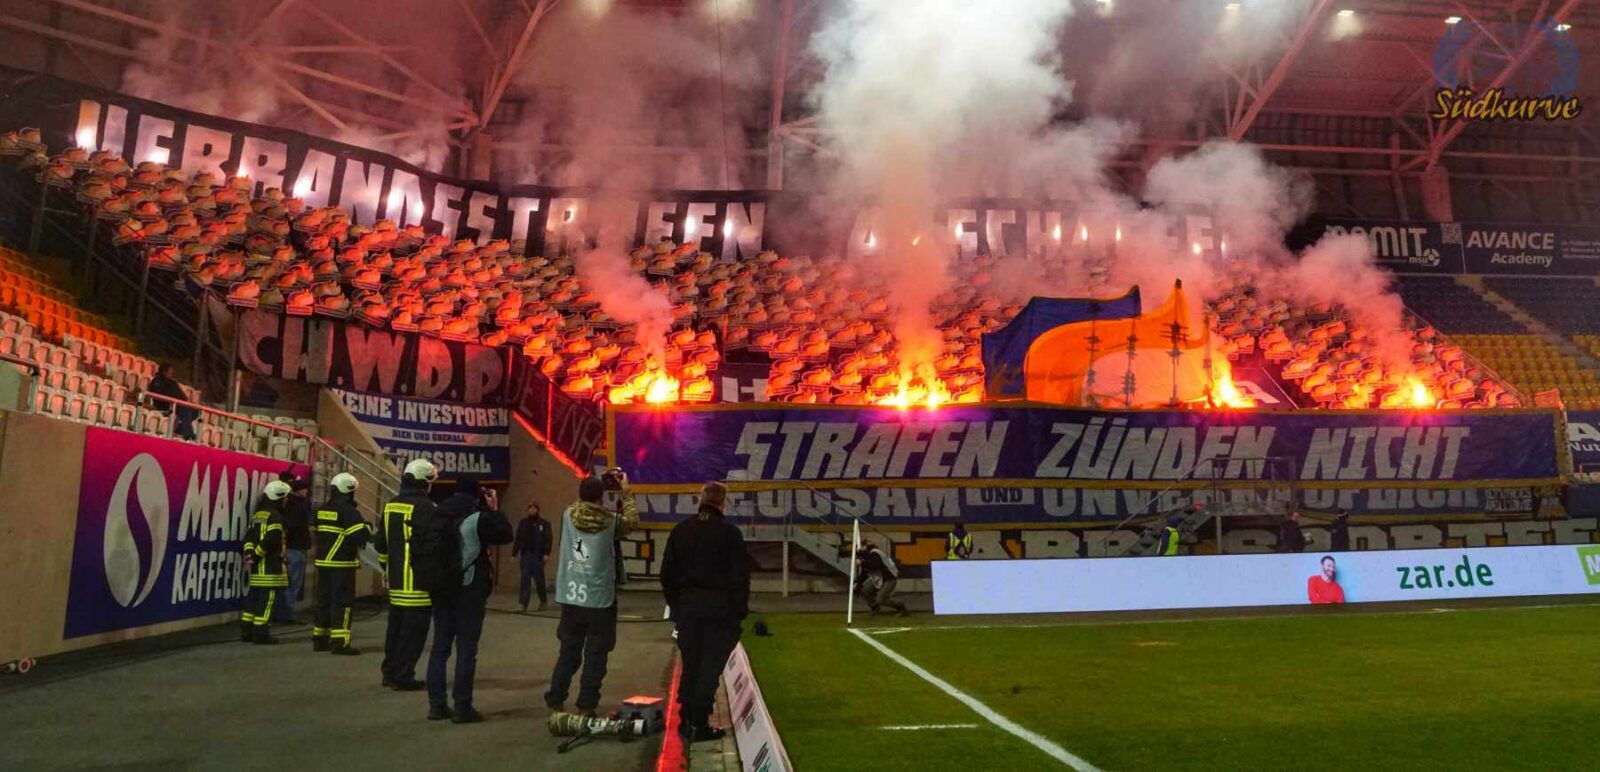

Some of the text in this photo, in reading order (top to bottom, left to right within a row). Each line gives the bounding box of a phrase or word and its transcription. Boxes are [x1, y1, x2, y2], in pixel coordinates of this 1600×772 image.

[1466, 231, 1555, 250] AVANCE
[1491, 252, 1554, 268] Academy
[398, 400, 509, 428] INVESTOREN
[392, 429, 411, 439] HIER
[413, 430, 430, 442] UND
[724, 417, 1472, 482] STRAFEN ZÜNDEN NICHT
[177, 460, 280, 542] MARK
[1397, 555, 1494, 590] zar.de
[566, 580, 588, 603] 35
